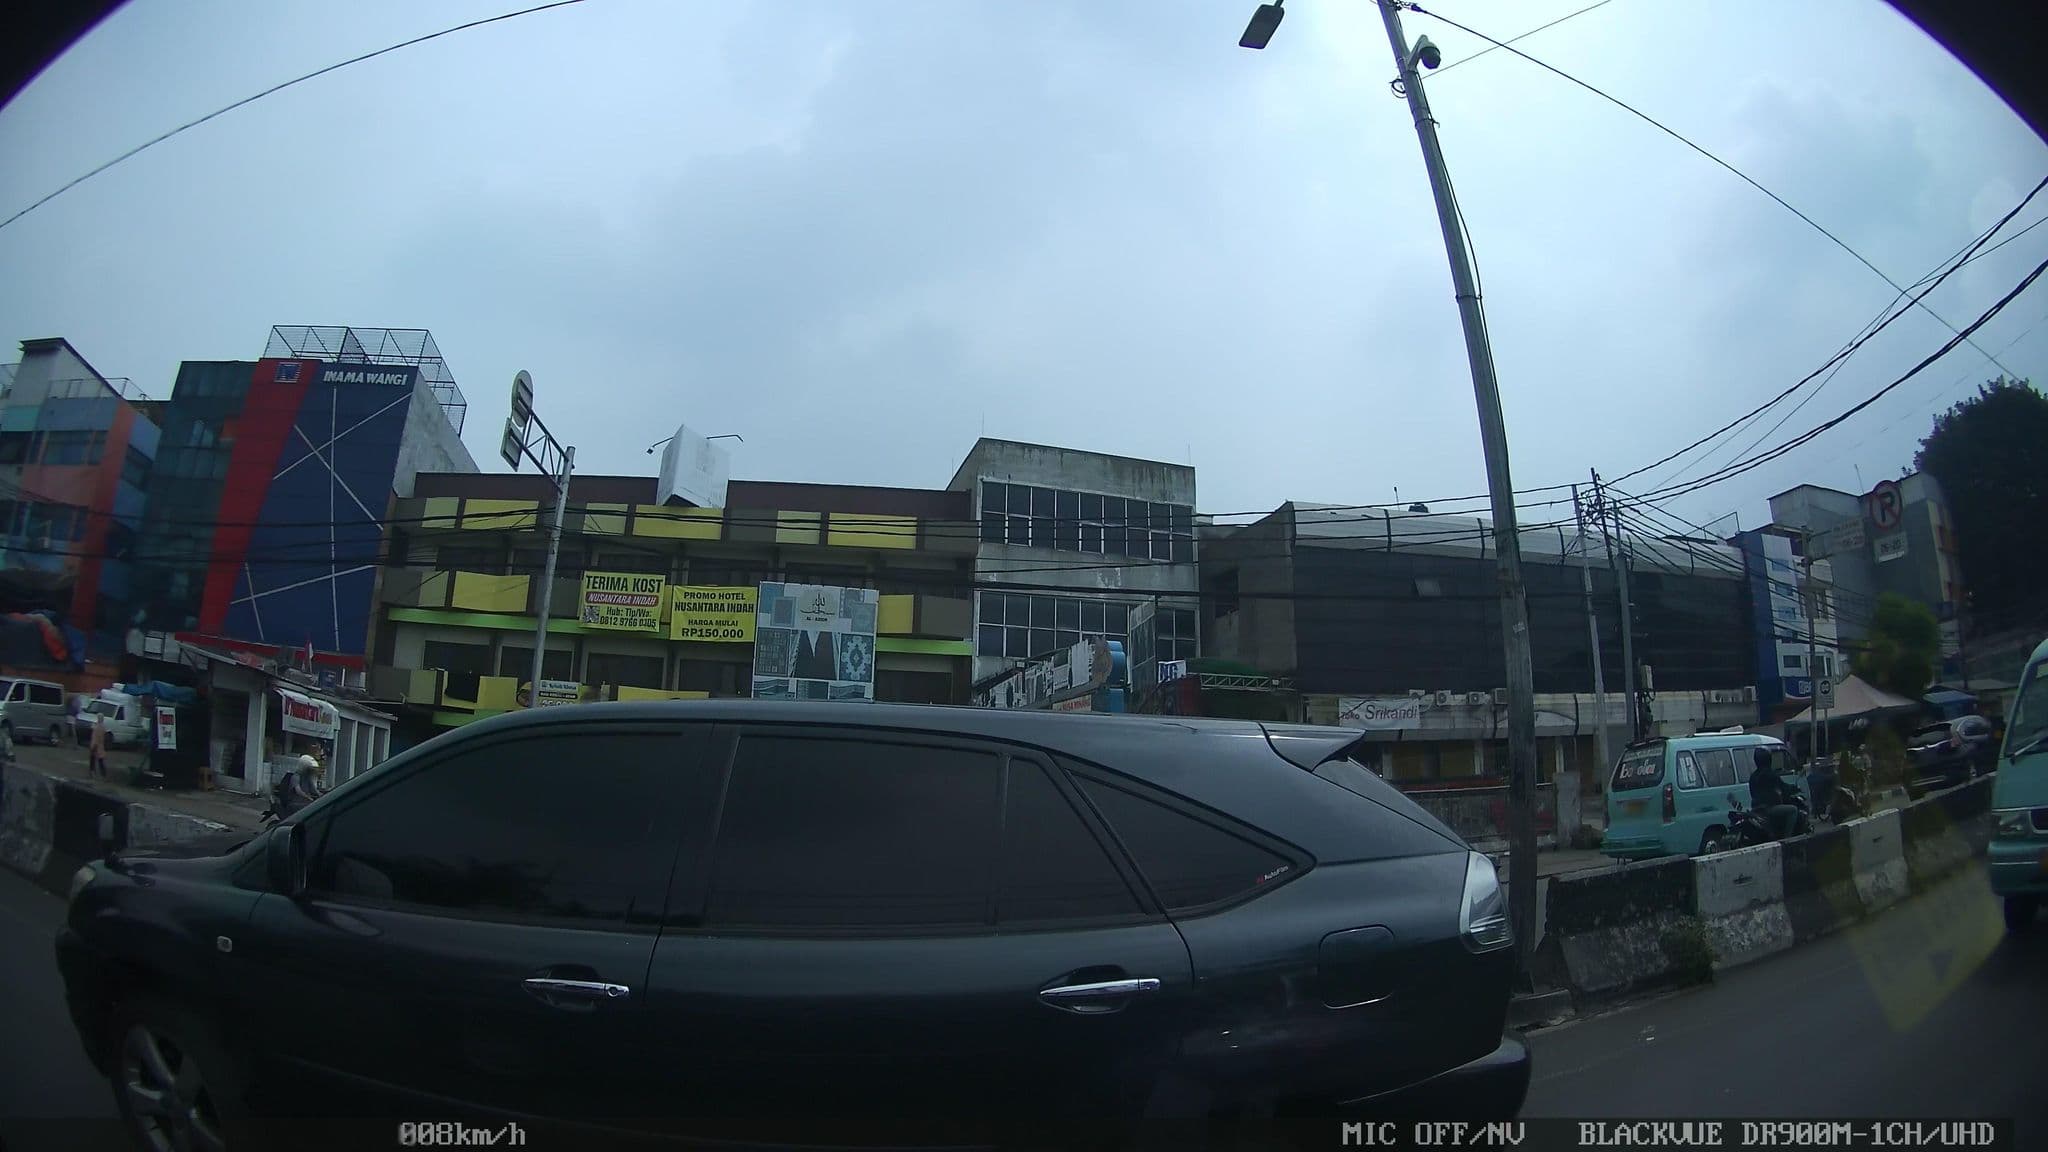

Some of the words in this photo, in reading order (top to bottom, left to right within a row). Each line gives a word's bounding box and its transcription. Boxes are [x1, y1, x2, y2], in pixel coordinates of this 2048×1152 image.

[366, 373, 408, 386] WANGI
[586, 575, 628, 592] TERIMA
[632, 577, 664, 594] KOST
[588, 593, 631, 605] NUSANTARA
[632, 595, 657, 606] INDAH
[684, 592, 717, 600] PROMO
[718, 592, 746, 601] HOTEL
[674, 601, 725, 613] NUSANTARA
[727, 602, 754, 613] INDAH
[1365, 704, 1418, 720] Srikandi
